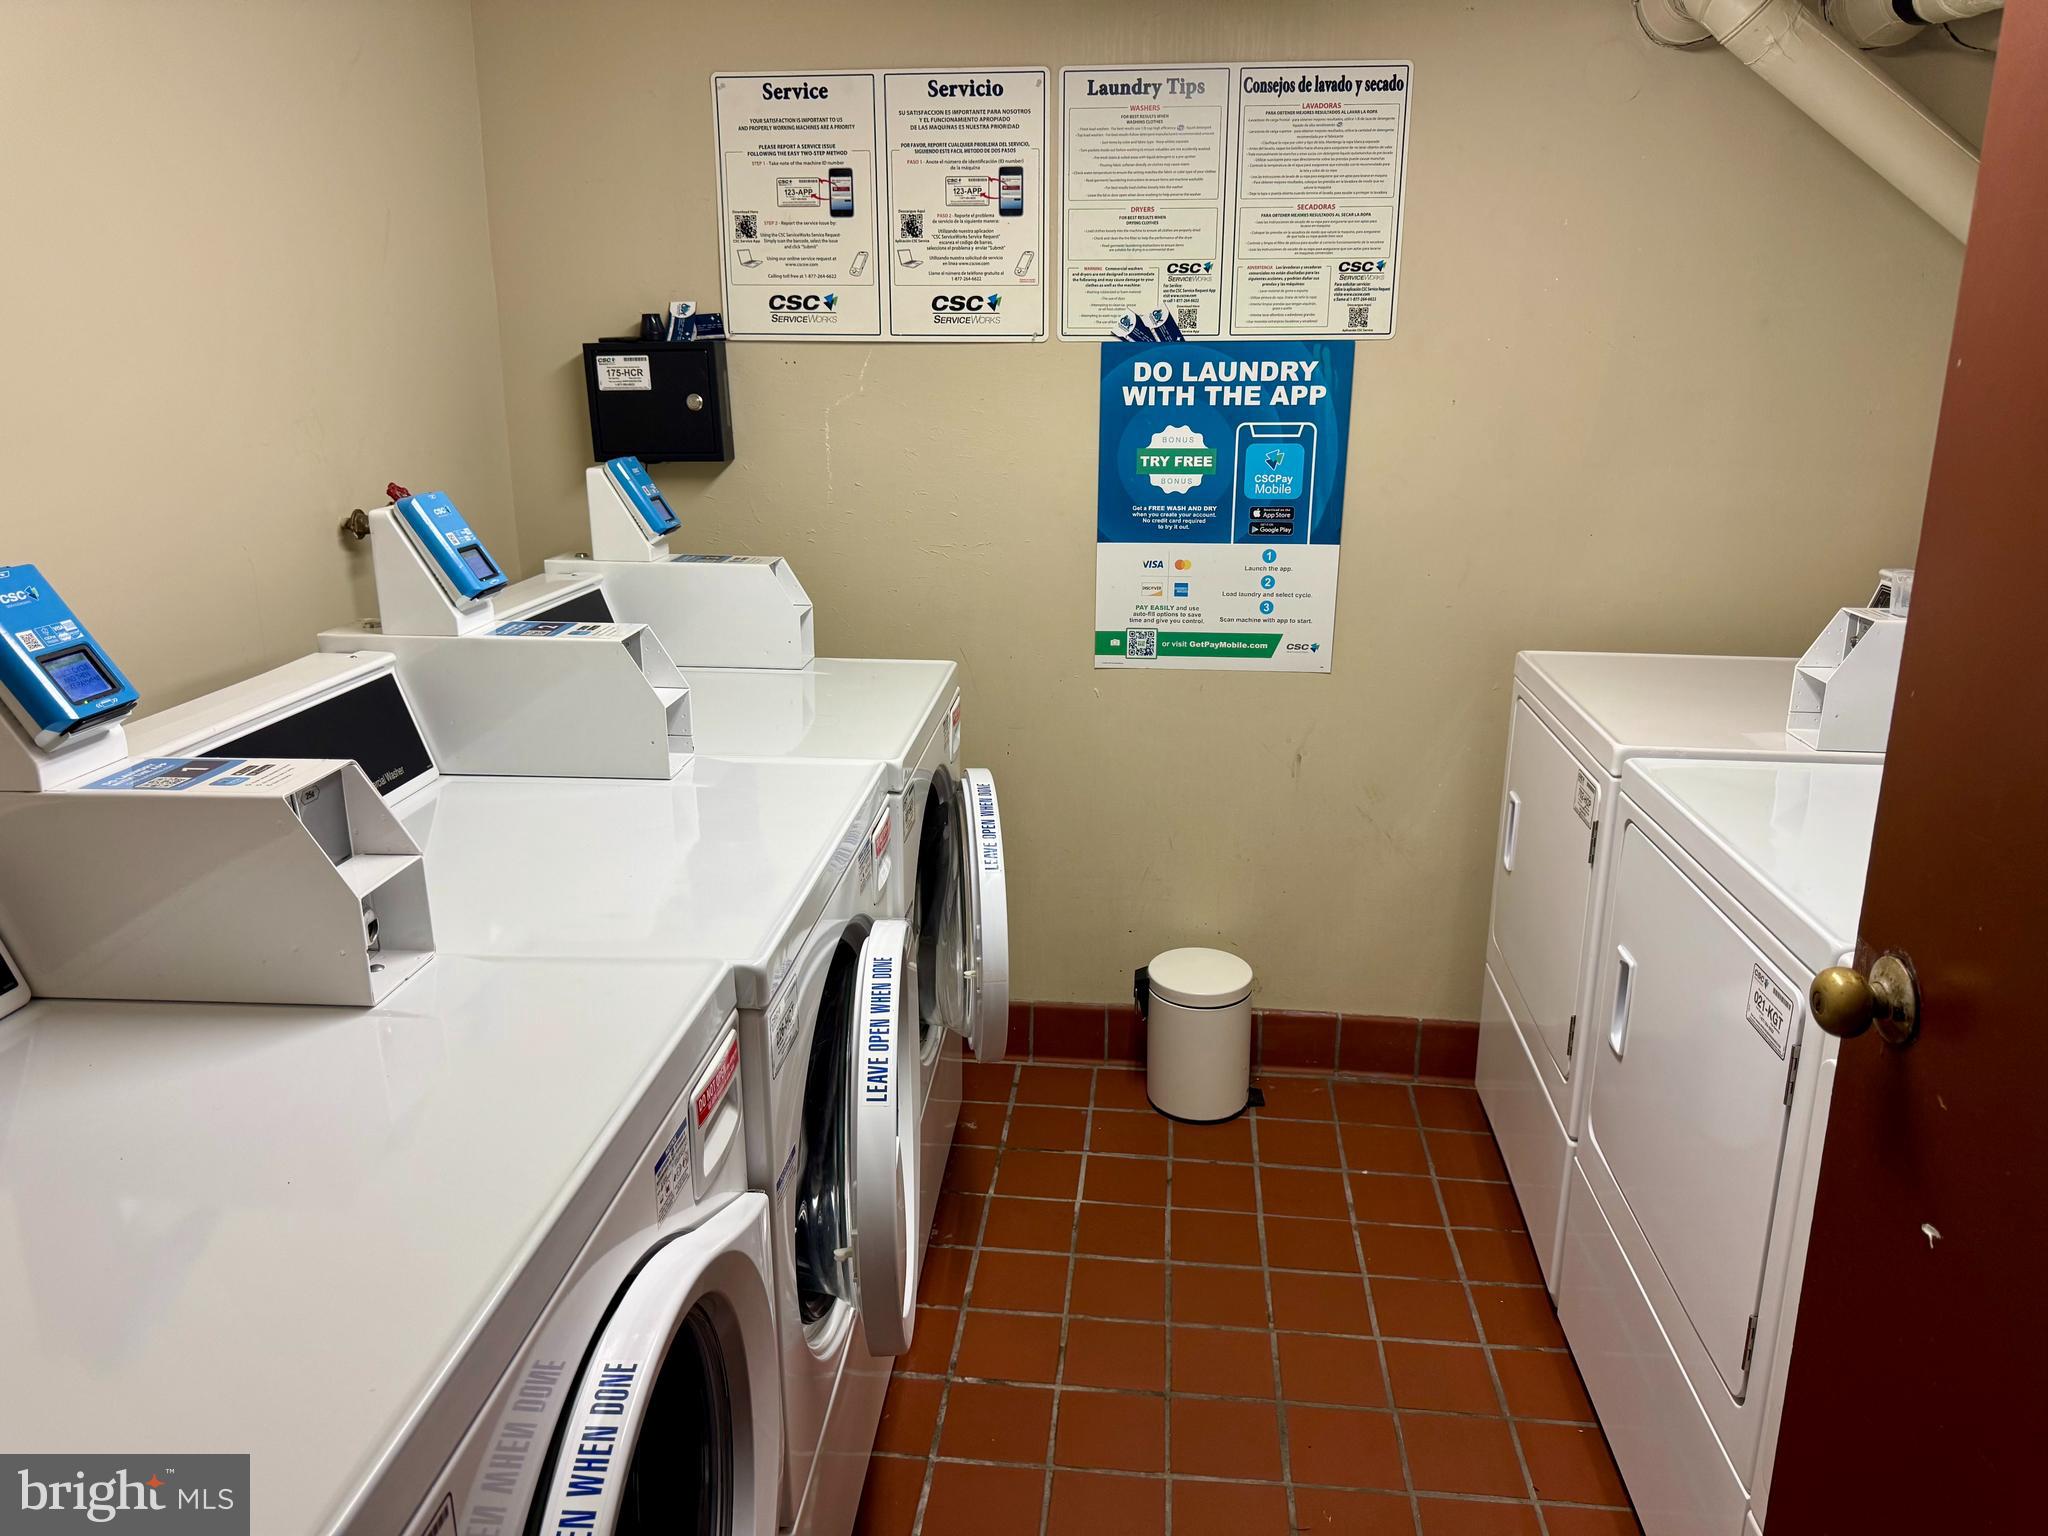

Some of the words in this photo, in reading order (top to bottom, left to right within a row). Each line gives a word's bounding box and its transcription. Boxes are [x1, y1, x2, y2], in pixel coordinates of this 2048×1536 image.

[762, 82, 828, 100] Service
[928, 79, 1003, 97] Servicio
[1087, 78, 1162, 100] Laundry
[1166, 78, 1205, 99] Tips
[1244, 77, 1295, 97] Consejos
[1298, 75, 1312, 93] de
[1315, 75, 1352, 92] lavado
[1356, 79, 1363, 96] y
[1365, 74, 1404, 91] secado
[1167, 263, 1201, 274] CSC
[1339, 262, 1374, 272] CSC
[769, 295, 820, 311] CSC
[932, 296, 983, 311] CSC
[1134, 362, 1172, 381] DO
[1182, 361, 1319, 382] LAUNDRY
[1122, 387, 1195, 406] WITH
[1204, 386, 1261, 406] THE
[1270, 386, 1327, 405] APP
[1162, 436, 1195, 444] BONUS
[1140, 456, 1171, 467] TRY
[1175, 456, 1212, 467] FREE
[1254, 475, 1293, 484] CSCPay
[1255, 484, 1291, 494] Mobile
[1143, 560, 1164, 568] VISA
[1267, 552, 1271, 560] 1
[1264, 577, 1271, 587] 2
[0, 591, 27, 604] CSC
[1263, 603, 1269, 612] 3
[1171, 639, 1187, 648] visit
[1189, 641, 1268, 649] GetPayMobile.com
[977, 783, 992, 796] DONE
[979, 798, 994, 816] WHEN
[981, 819, 996, 839] OPEN
[983, 842, 999, 870] LEAVE
[872, 957, 892, 979] DONE
[1754, 969, 1765, 983] CSC
[870, 983, 891, 1014] WHEN
[1754, 991, 1783, 1030] 021-KGT
[868, 1019, 890, 1051] OPEN
[866, 1057, 888, 1102] LEAVE
[590, 1363, 638, 1415] DONE
[566, 1426, 619, 1497] WHEN
